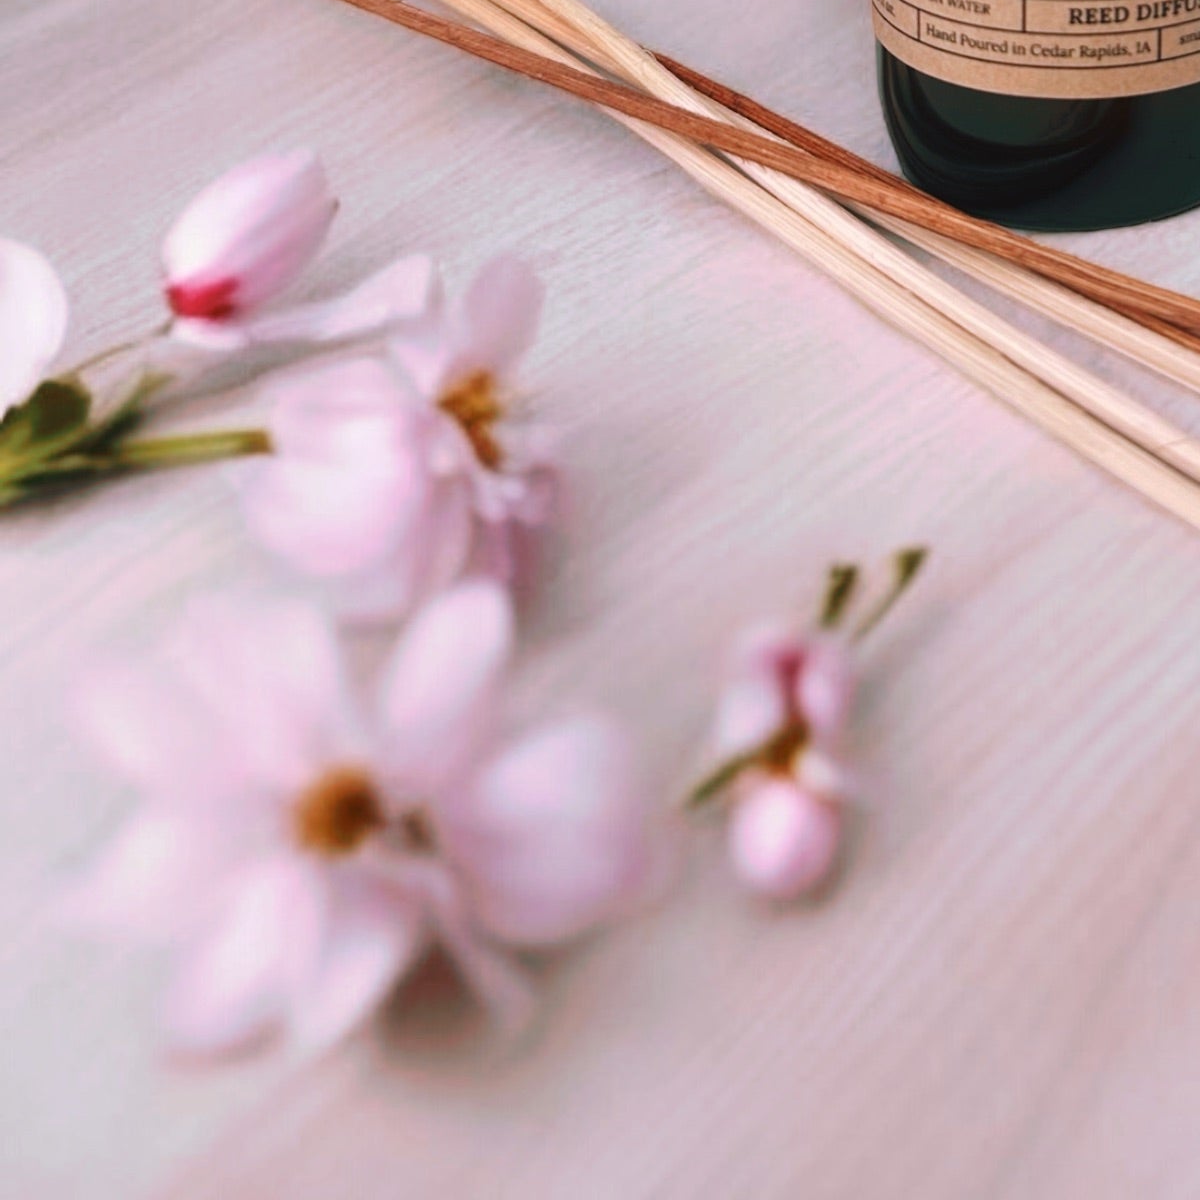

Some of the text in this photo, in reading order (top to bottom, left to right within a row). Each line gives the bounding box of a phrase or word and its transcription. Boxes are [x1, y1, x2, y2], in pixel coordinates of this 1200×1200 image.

[1068, 6, 1131, 26] REED
[926, 23, 1152, 62] Hand Poured in Cedar Rapids, IA
